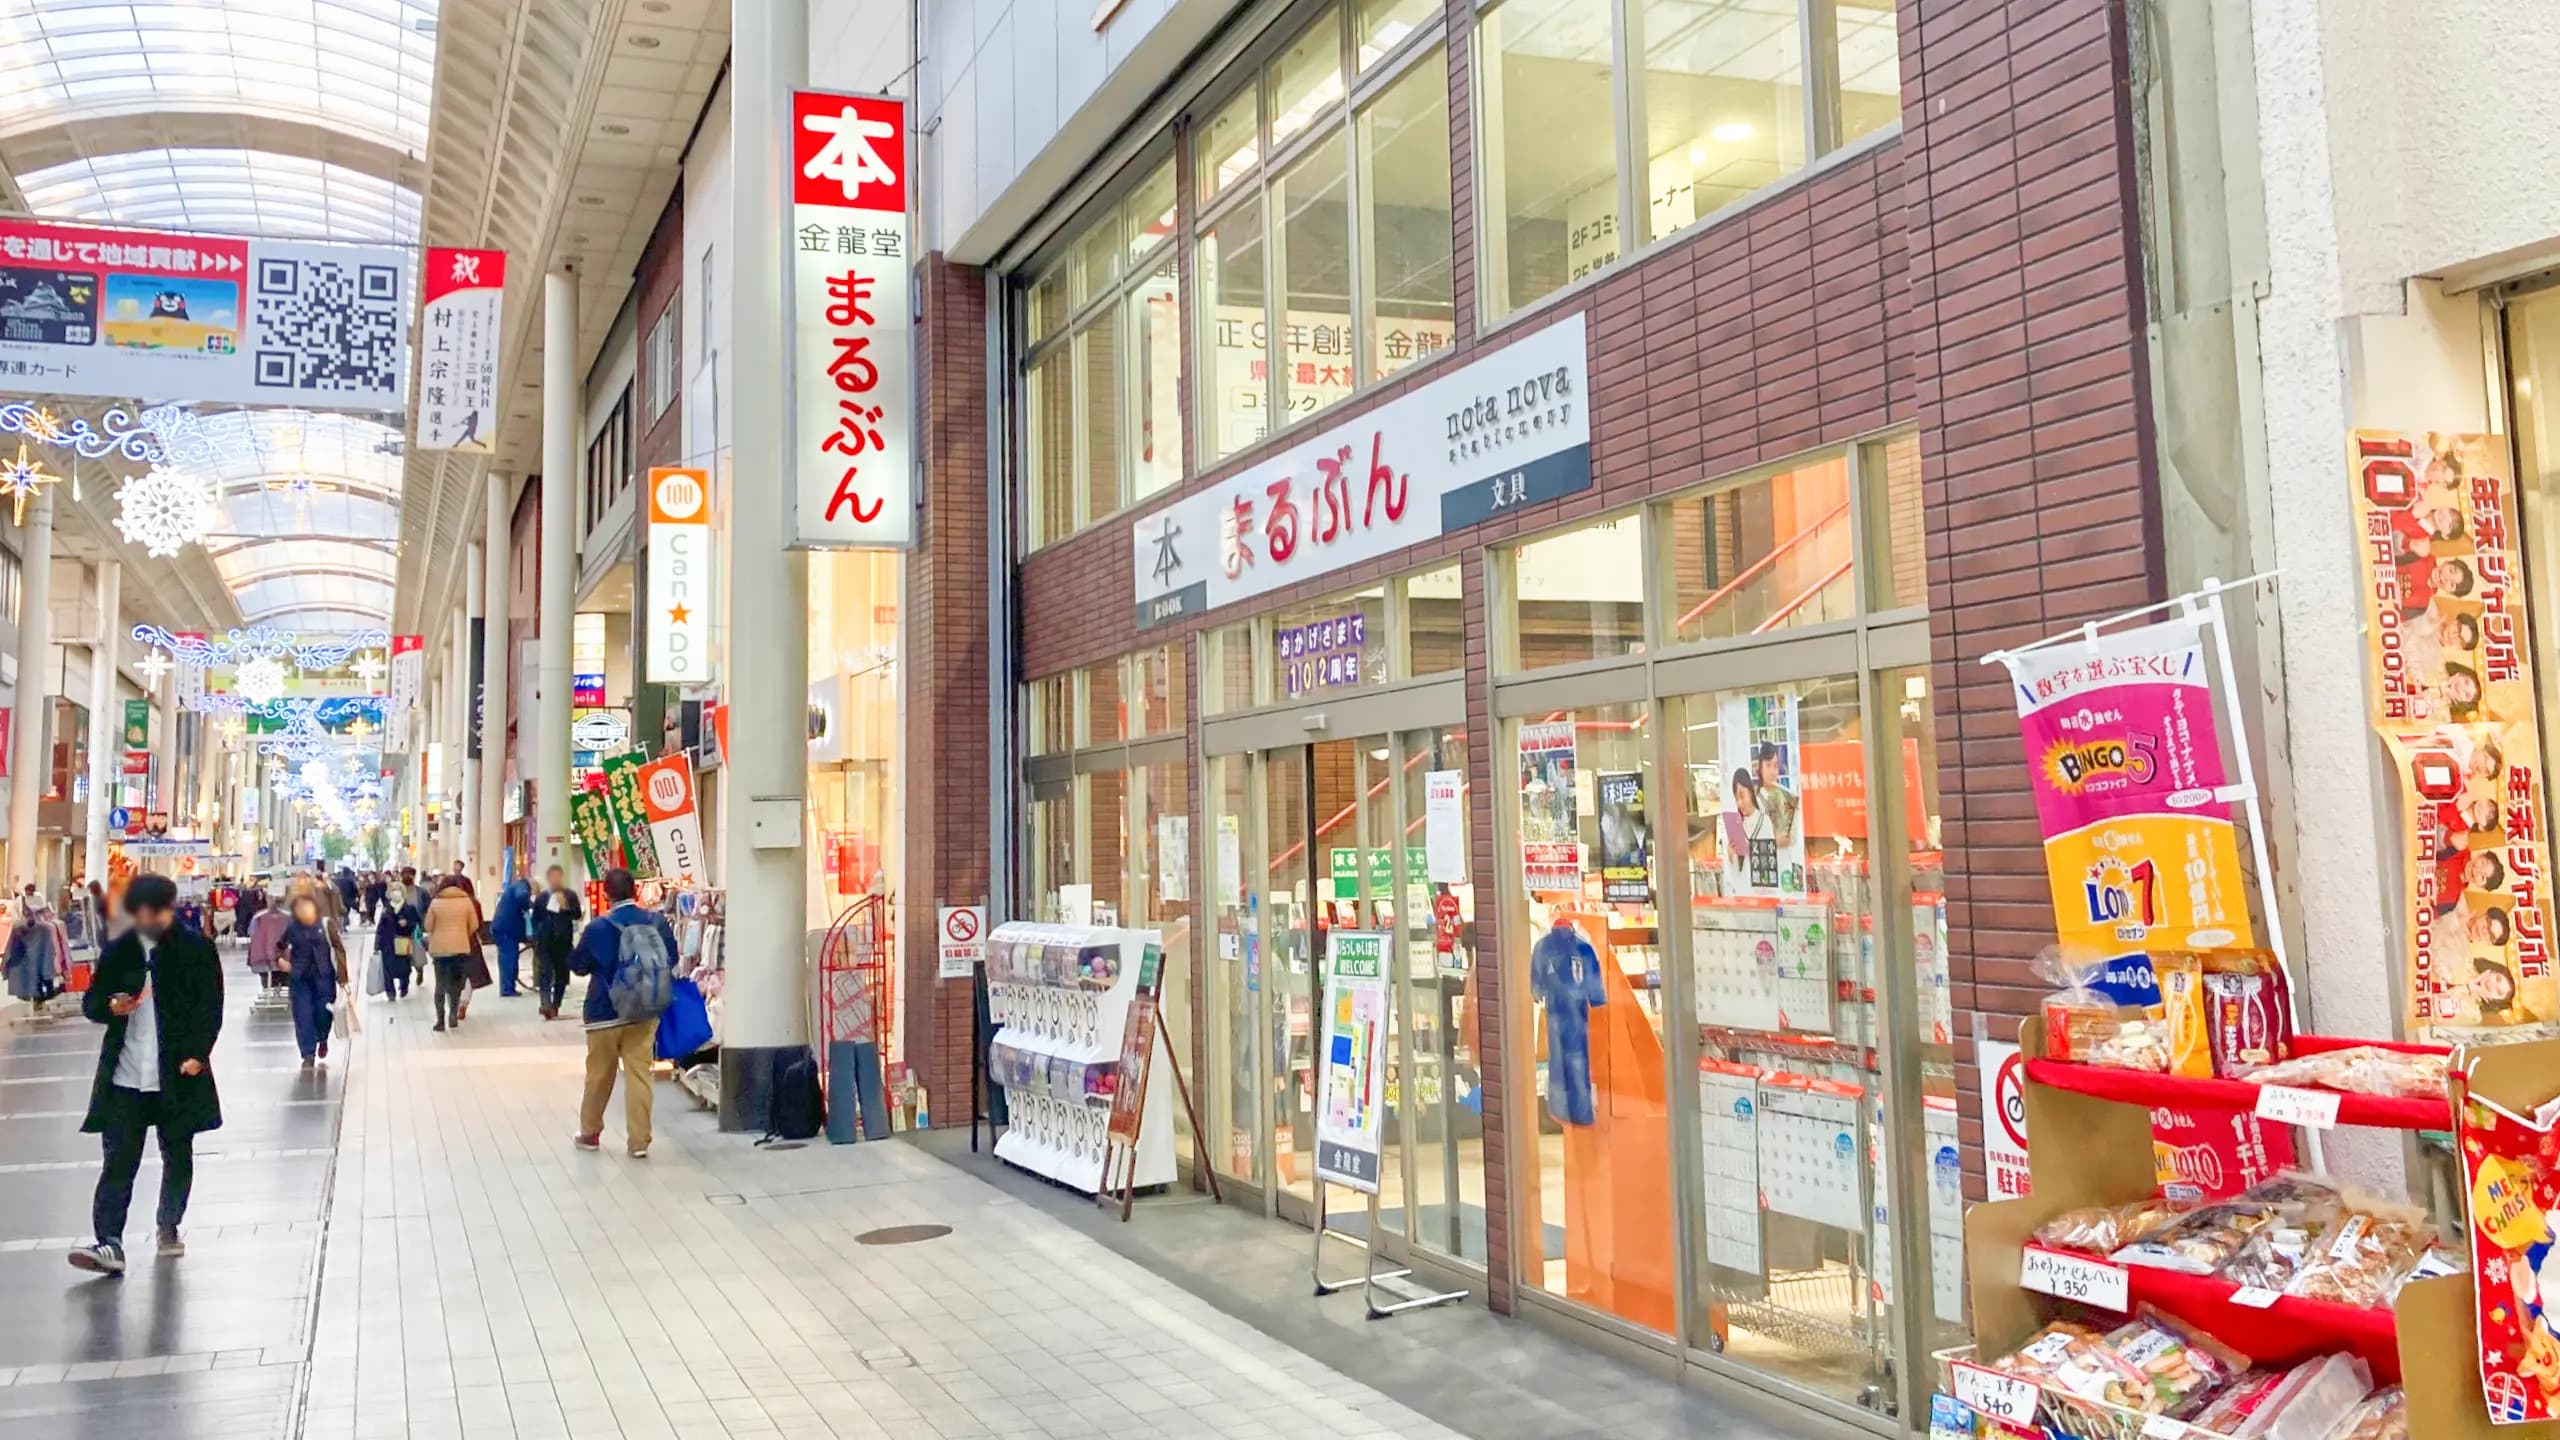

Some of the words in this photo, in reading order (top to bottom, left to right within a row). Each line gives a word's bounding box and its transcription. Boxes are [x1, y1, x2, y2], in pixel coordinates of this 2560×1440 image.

[803, 105, 895, 200] 本
[451, 253, 480, 284] 祝
[799, 223, 902, 258] 金龍堂
[428, 308, 452, 442] 村上宗隆選手
[821, 270, 884, 523] まるぶん
[1446, 396, 1498, 440] nota
[1506, 366, 1570, 415] nova
[1449, 403, 1571, 464] stationery
[666, 484, 694, 505] 100
[1220, 431, 1411, 582] まるぶん
[1491, 471, 1528, 511] 文具
[1152, 517, 1184, 588] 本
[2471, 476, 2522, 684] 年末ジャンボ
[1153, 599, 1184, 621] BOOK
[1280, 615, 1364, 659] おかげさまで
[1290, 656, 1358, 691] 102周年
[2036, 655, 2178, 699] 数字を選ぶ宝くじ
[2060, 745, 2125, 783] BINGO
[2126, 731, 2158, 784] 5
[2131, 859, 2155, 926] 7
[2506, 765, 2551, 979] 年末ジャンボ
